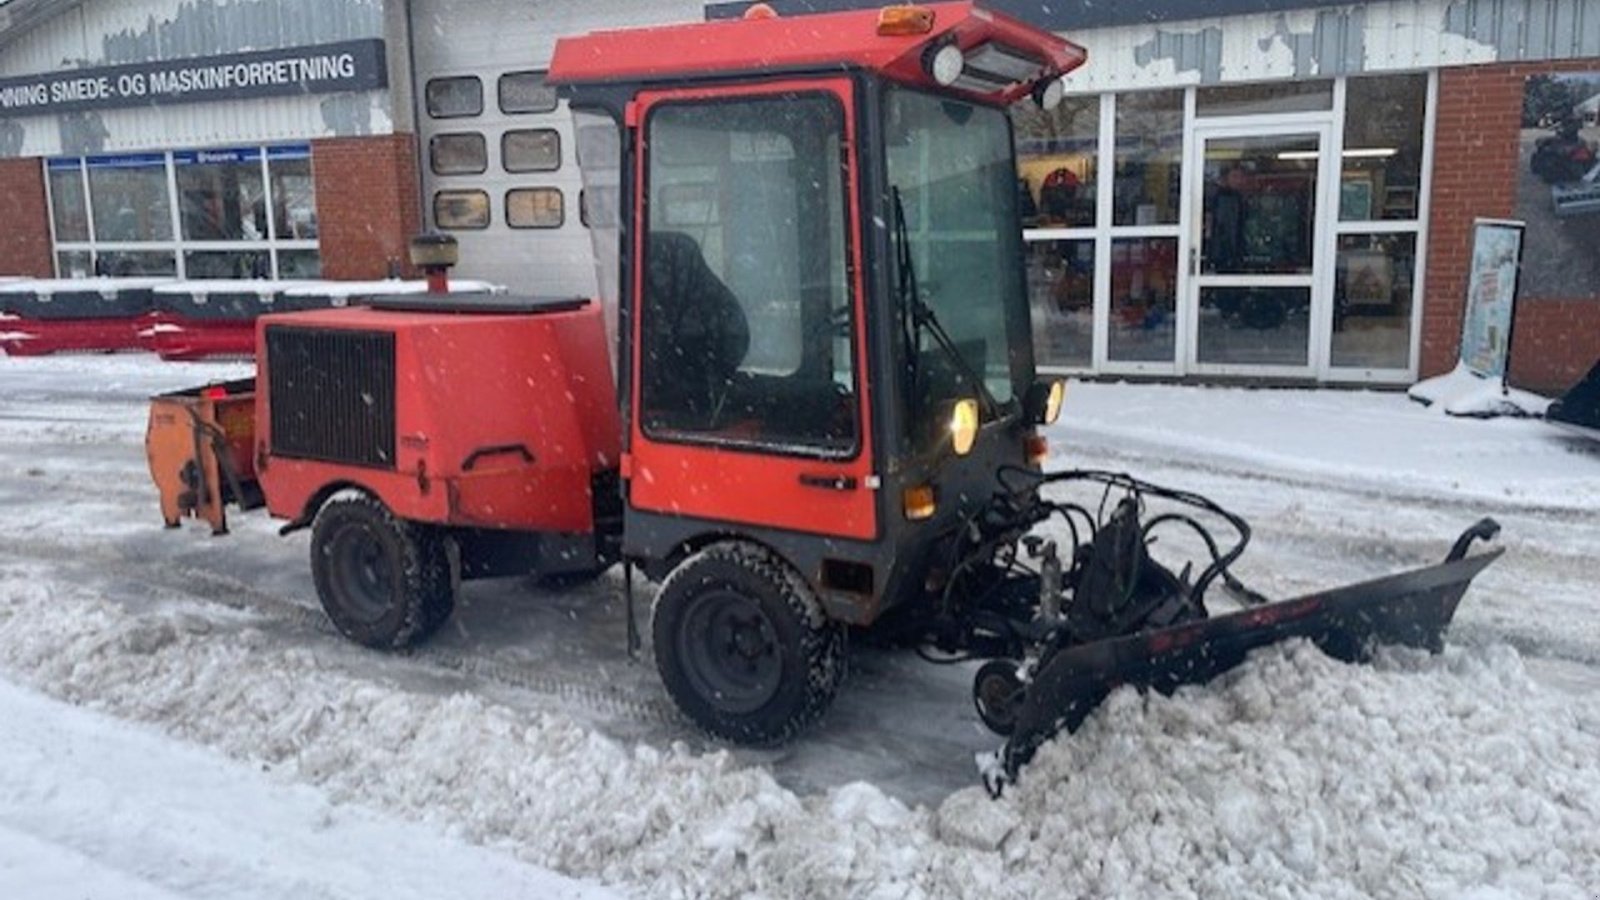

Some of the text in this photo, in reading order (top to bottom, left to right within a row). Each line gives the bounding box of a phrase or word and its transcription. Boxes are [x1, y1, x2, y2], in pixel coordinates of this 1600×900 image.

[50, 78, 115, 102] SMEDE-
[118, 73, 146, 96] OG
[149, 53, 354, 94] MASKINFORRETNING
